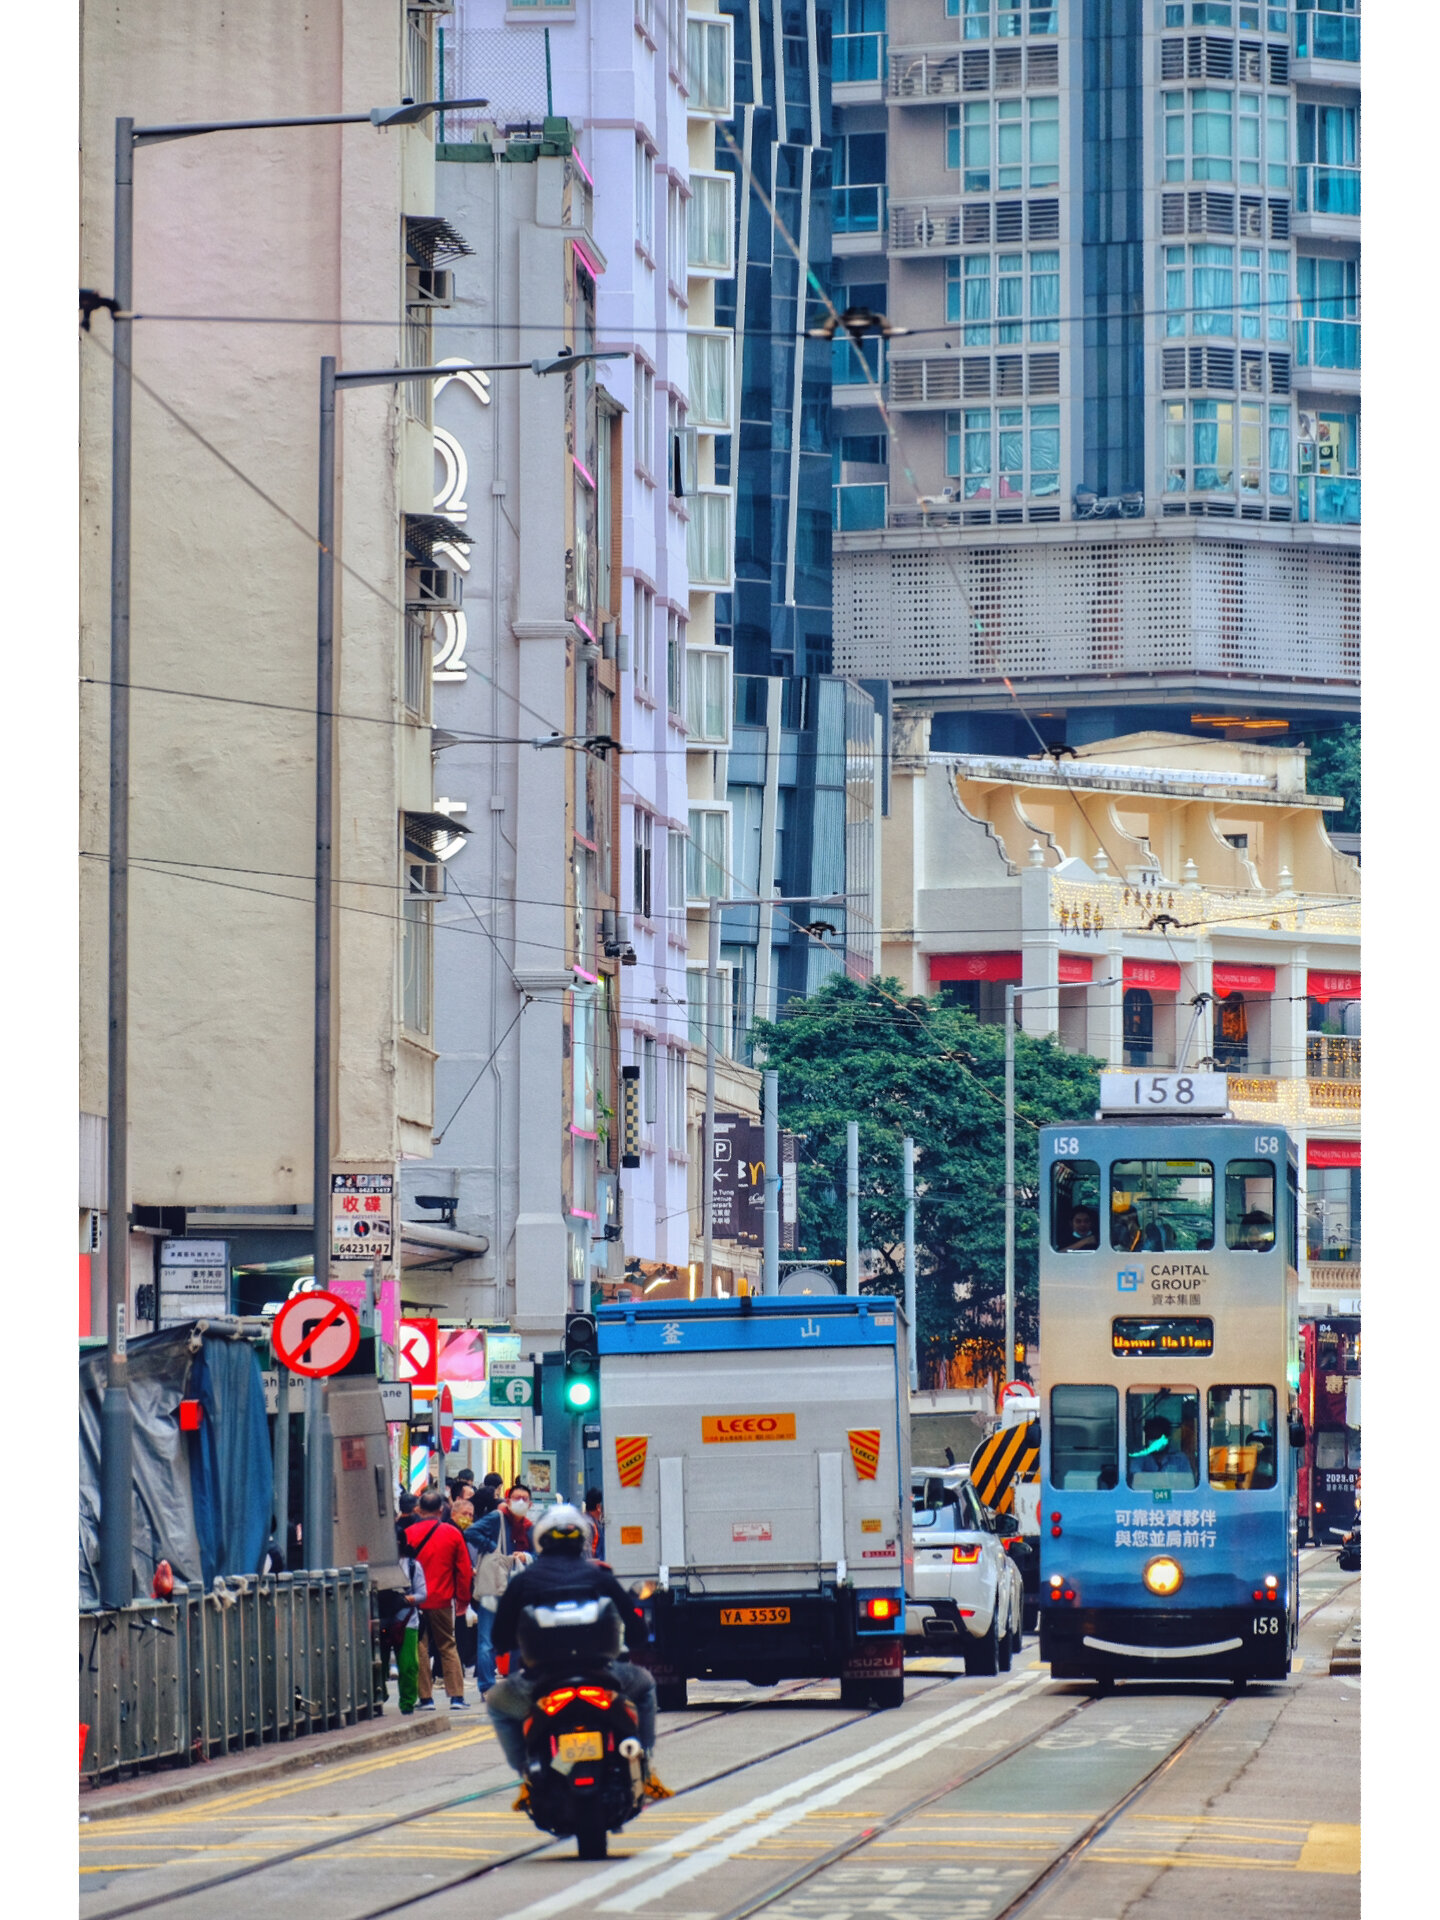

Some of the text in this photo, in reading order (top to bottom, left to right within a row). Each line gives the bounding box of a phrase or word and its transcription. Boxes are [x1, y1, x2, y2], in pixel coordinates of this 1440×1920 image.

[1134, 1077, 1196, 1104] 158
[1054, 1138, 1079, 1155] 158
[1254, 1136, 1279, 1154] 158
[343, 1195, 381, 1213] 收碟
[1151, 1264, 1210, 1276] CAPITAL
[1151, 1279, 1202, 1290] GROUP
[1151, 1293, 1201, 1306] 資本集團
[660, 1318, 821, 1346] 釜 山
[382, 1389, 403, 1399] ane
[716, 1418, 778, 1433] LEEO
[1114, 1508, 1217, 1528] 可靠投資夥伴
[1114, 1529, 1217, 1548] 與您並肩前行
[723, 1609, 787, 1623] YA 3539
[1253, 1616, 1279, 1635] 158
[848, 1656, 894, 1668] ISUZU
